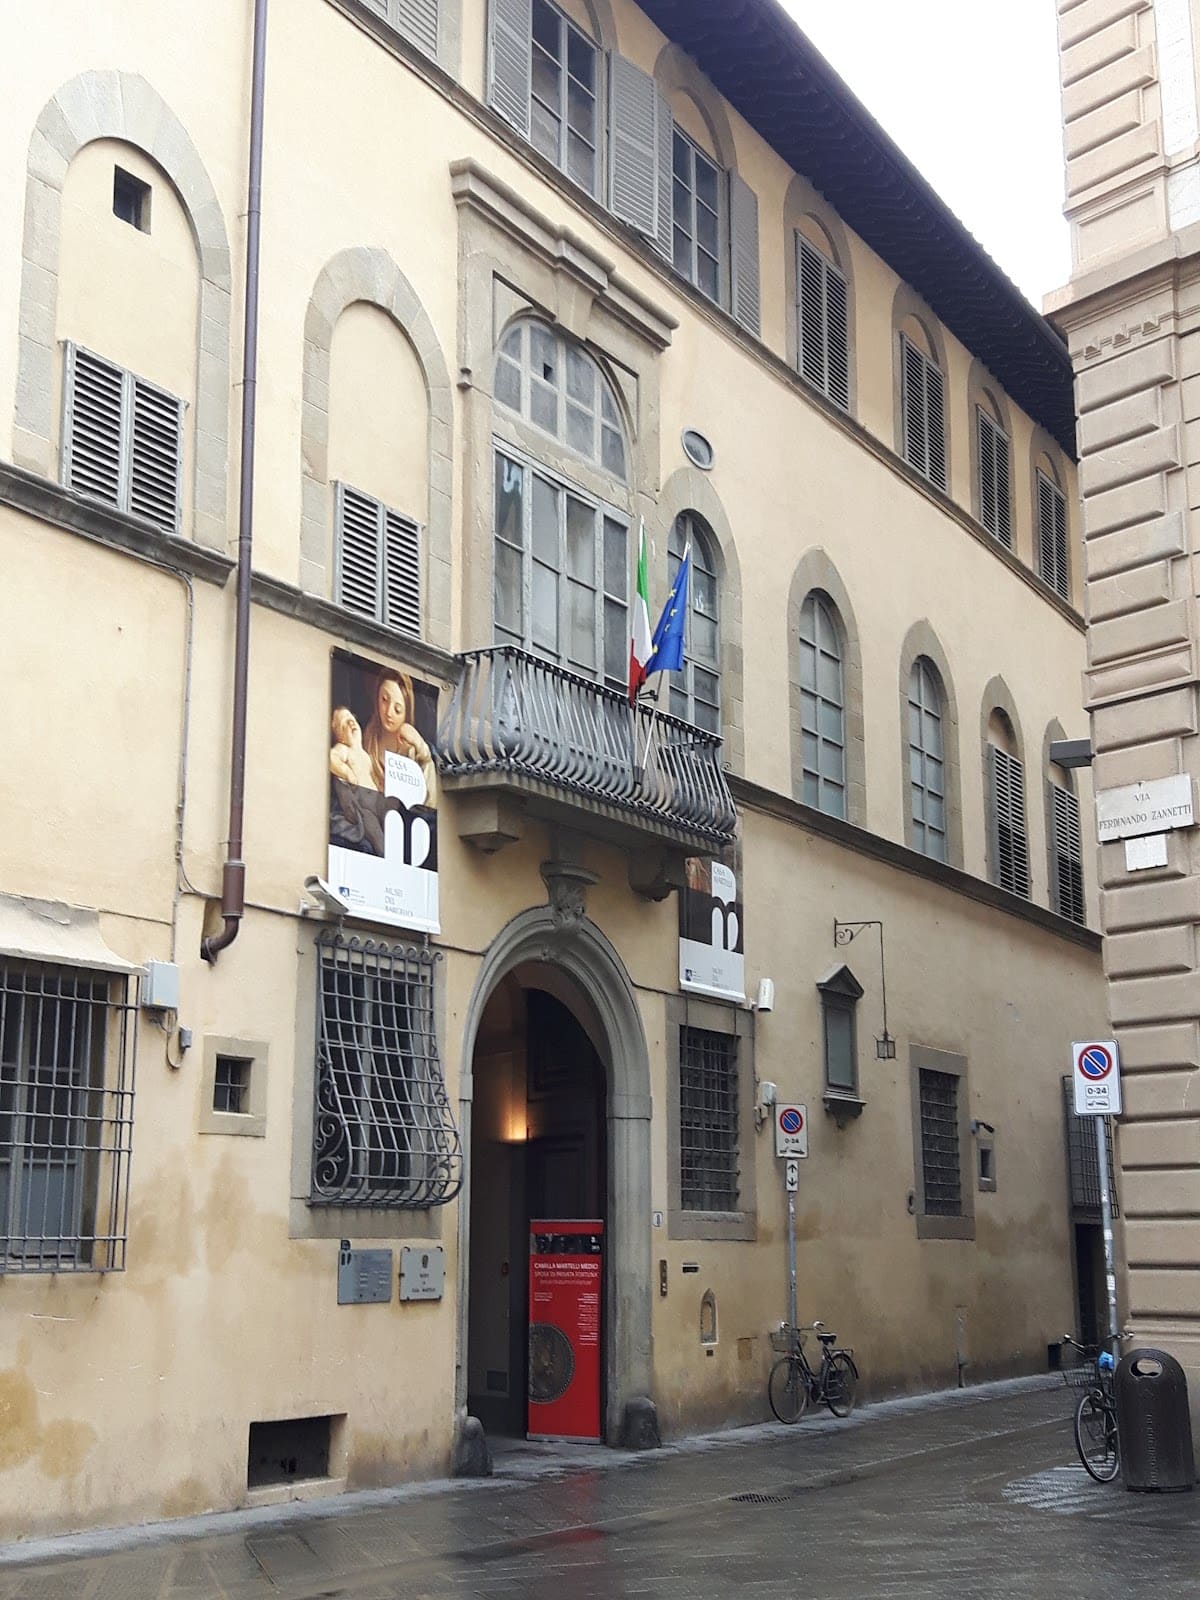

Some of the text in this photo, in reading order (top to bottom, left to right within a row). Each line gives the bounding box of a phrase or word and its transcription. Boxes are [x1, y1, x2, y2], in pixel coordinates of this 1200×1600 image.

[388, 757, 408, 771] CASA
[1134, 792, 1151, 802] VIA
[1099, 803, 1192, 830] FERDINANDO ZANNETTI
[1087, 1087, 1107, 1095] 0-24
